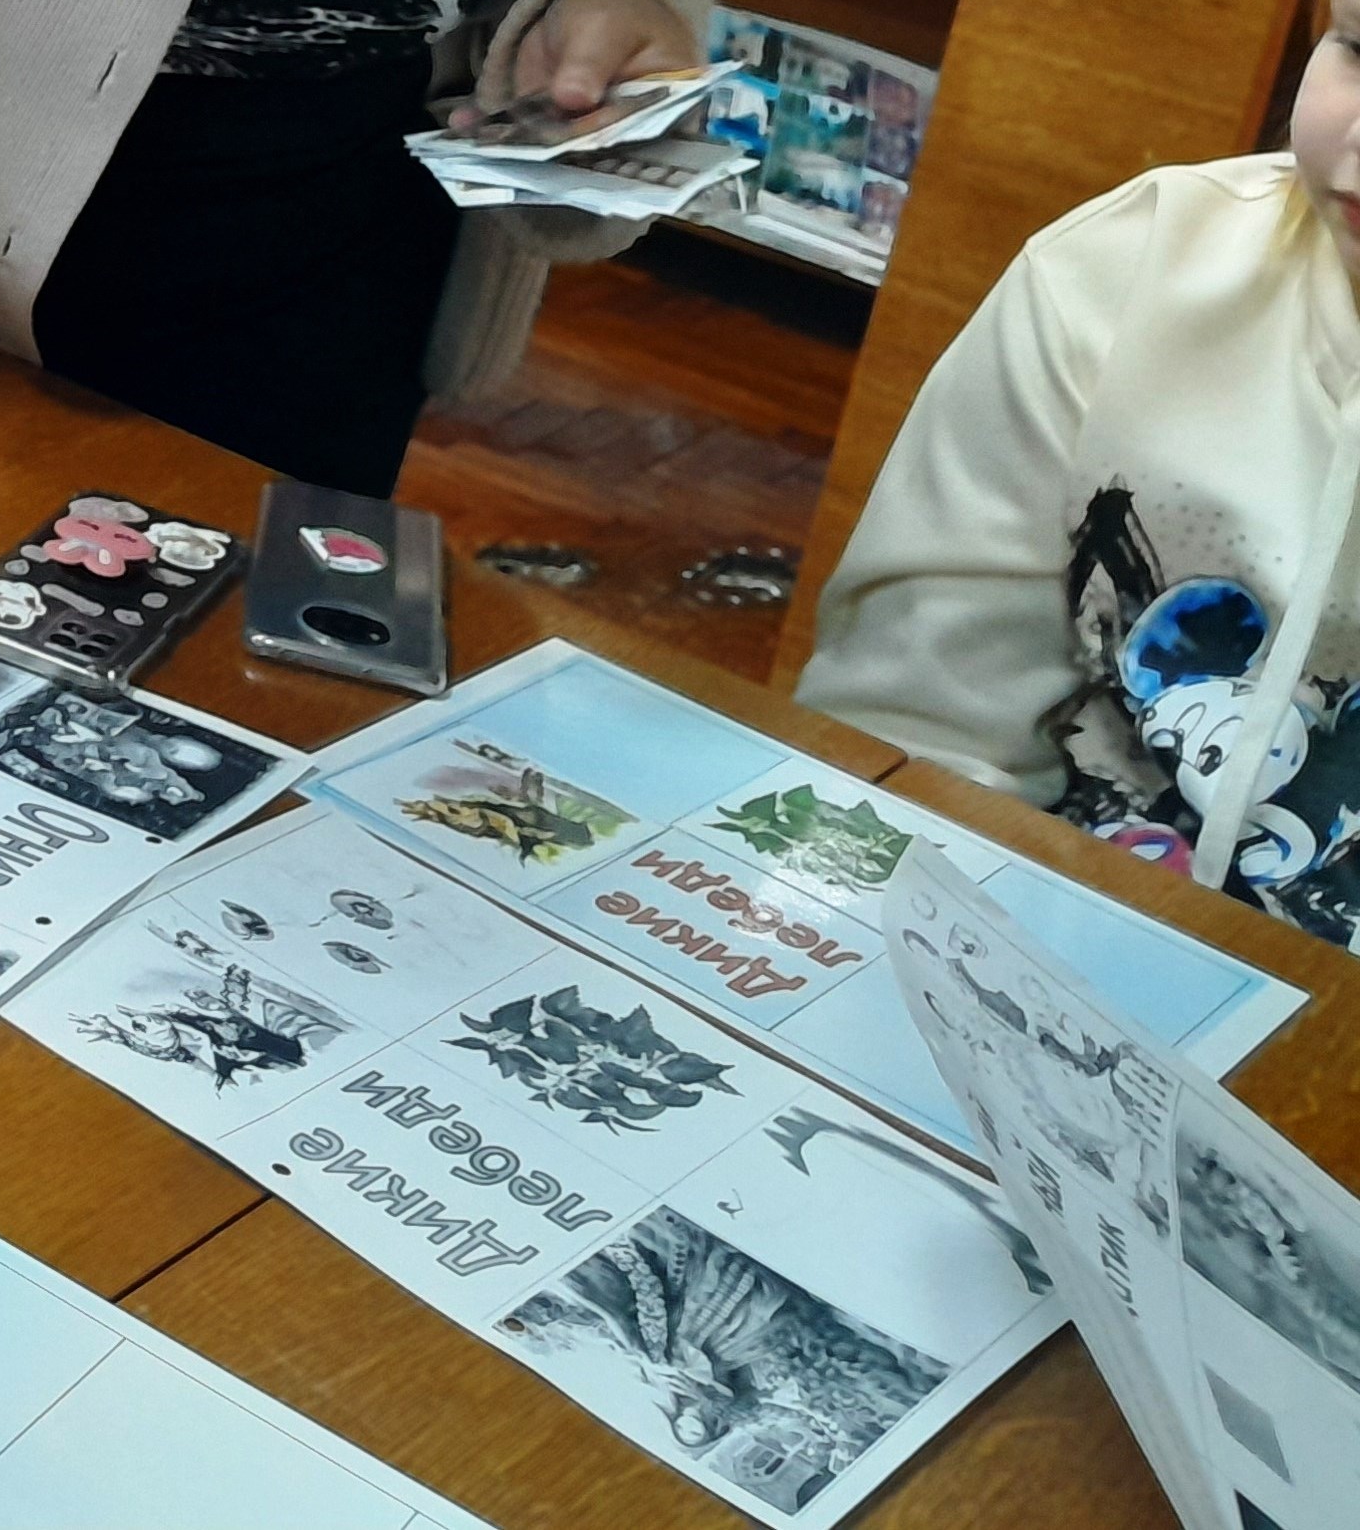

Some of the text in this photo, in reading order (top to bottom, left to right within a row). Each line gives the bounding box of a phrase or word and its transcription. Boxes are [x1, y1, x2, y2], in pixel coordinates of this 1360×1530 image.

[594, 891, 808, 999] Дикие
[630, 849, 864, 968] лебеди
[289, 1127, 541, 1278] Дикие
[340, 1070, 614, 1233] лебеди
